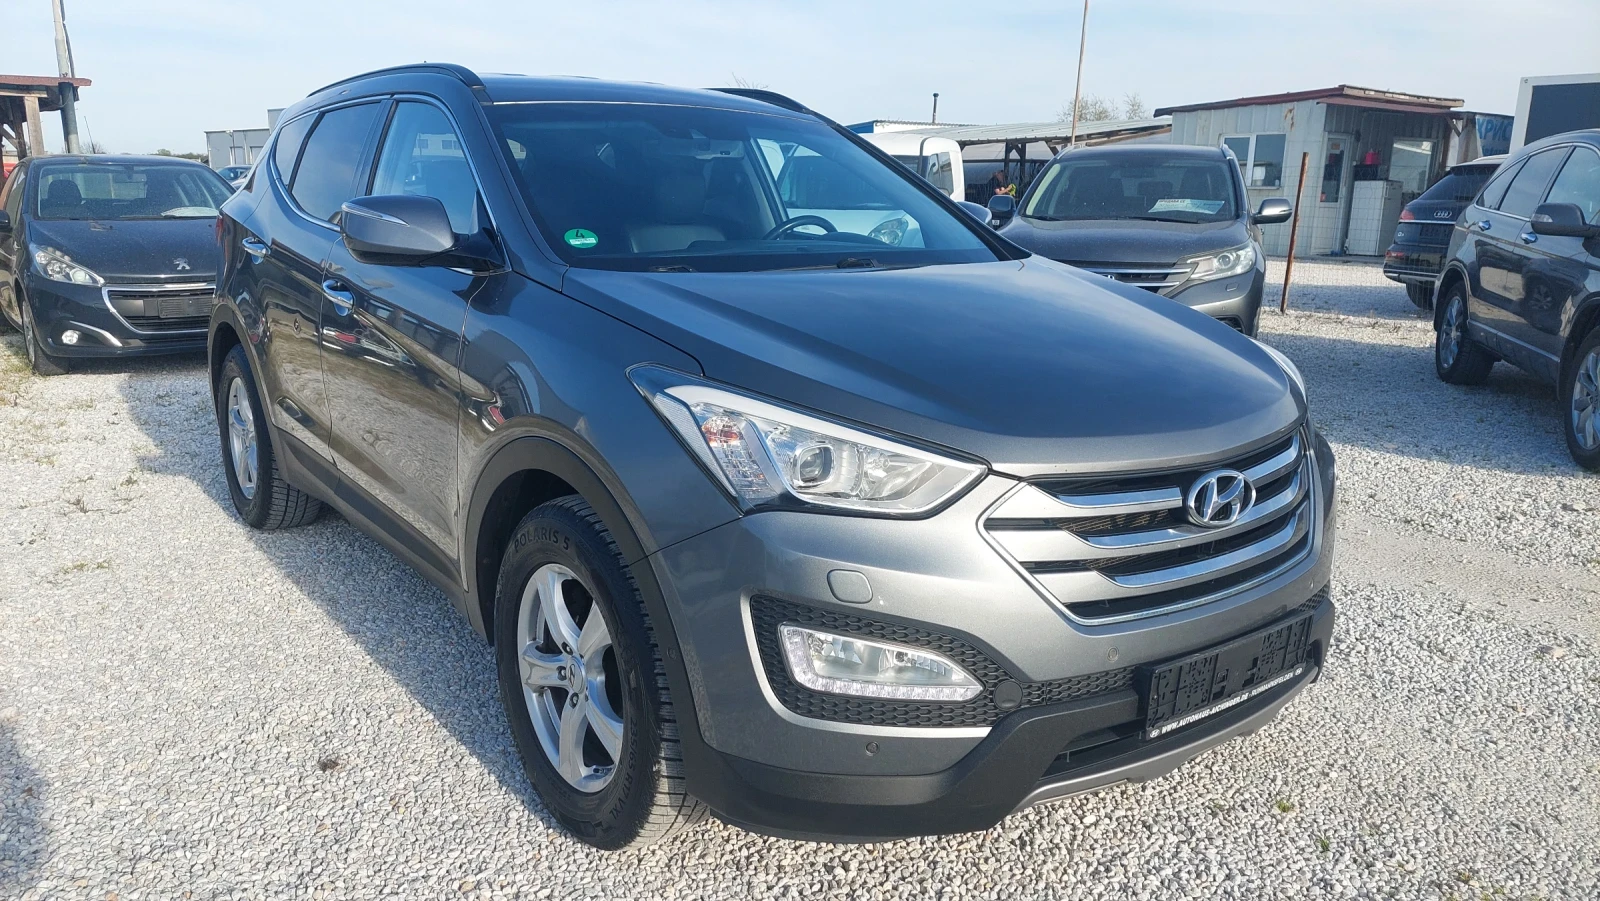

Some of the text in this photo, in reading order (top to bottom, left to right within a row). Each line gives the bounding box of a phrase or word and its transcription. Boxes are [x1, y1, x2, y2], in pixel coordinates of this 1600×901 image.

[575, 229, 585, 238] 4
[514, 526, 570, 553] POLARIS 5
[628, 716, 638, 772] 235/65
[622, 771, 634, 800] R17
